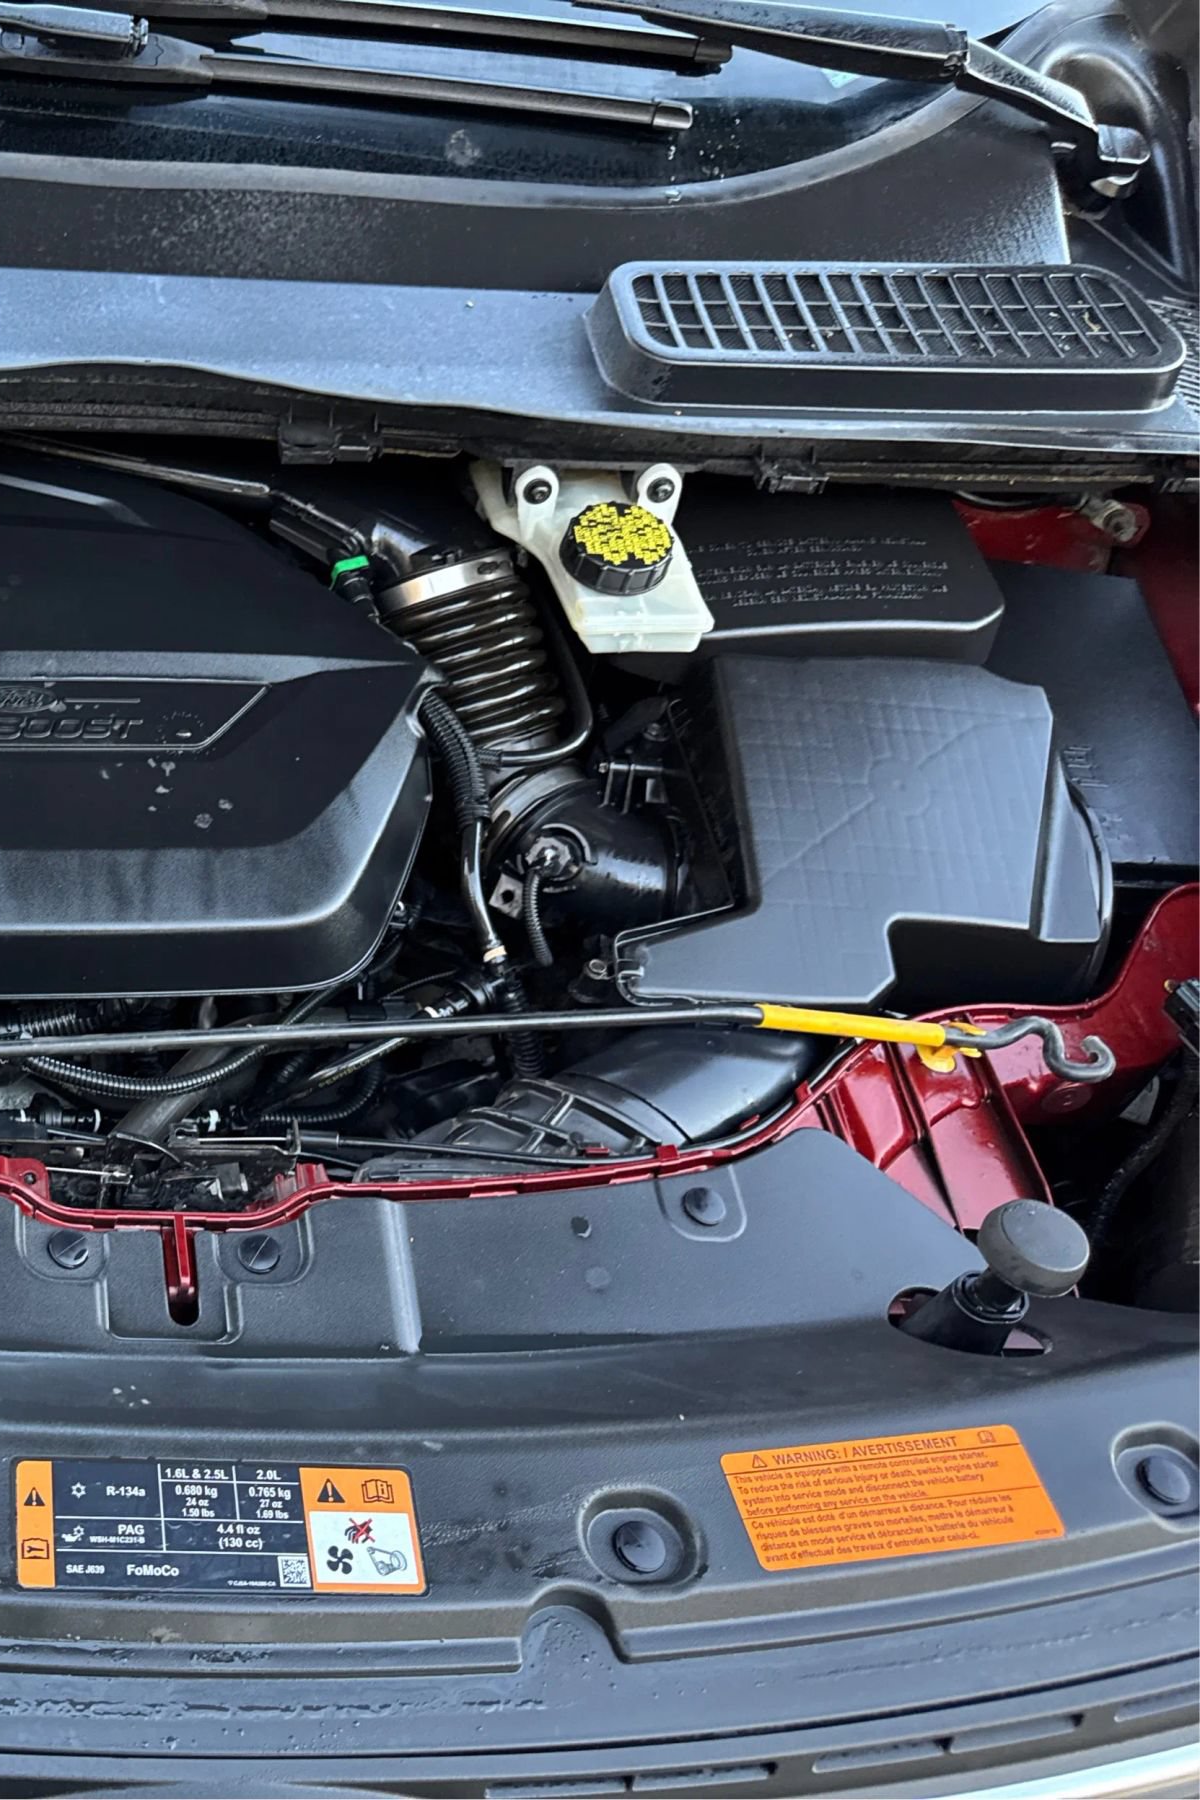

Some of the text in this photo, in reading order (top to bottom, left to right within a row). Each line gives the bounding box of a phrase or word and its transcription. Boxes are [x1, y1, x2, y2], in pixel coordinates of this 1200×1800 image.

[771, 1435, 957, 1465] WARNING: AVERTISSEMENT
[164, 1467, 229, 1480] 1.6L & 2.5L
[255, 1468, 281, 1480] 2.0L
[732, 1454, 958, 1484] This vehicle is equipped with a remote controlled engine
[736, 1485, 749, 1495] To
[749, 1483, 780, 1493] reduce
[779, 1481, 794, 1490] the
[794, 1479, 812, 1488] risk
[811, 1477, 822, 1487] of
[822, 1476, 854, 1486] serious
[878, 1471, 888, 1480] or
[915, 1465, 944, 1476] switch
[943, 1463, 972, 1473] engine
[105, 1485, 146, 1497] R-134a
[174, 1483, 218, 1499] 0.680 kg
[247, 1485, 291, 1500] 0.765 kg
[741, 1473, 984, 1507] system into service mode and disconnect the vehicle battery
[185, 1496, 209, 1507] 24 oz
[258, 1498, 283, 1509] 27 oz
[745, 1493, 897, 1516] before performing any service on the
[181, 1507, 215, 1518] 1.50 lbs
[255, 1508, 289, 1519] 1.69 lbs
[117, 1523, 145, 1535] PAG
[216, 1523, 234, 1534] 4.4
[245, 1525, 261, 1535] oz
[217, 1536, 264, 1550] (130 cc)
[65, 1563, 105, 1574] SAE J639
[126, 1563, 179, 1576] FoMoCo
